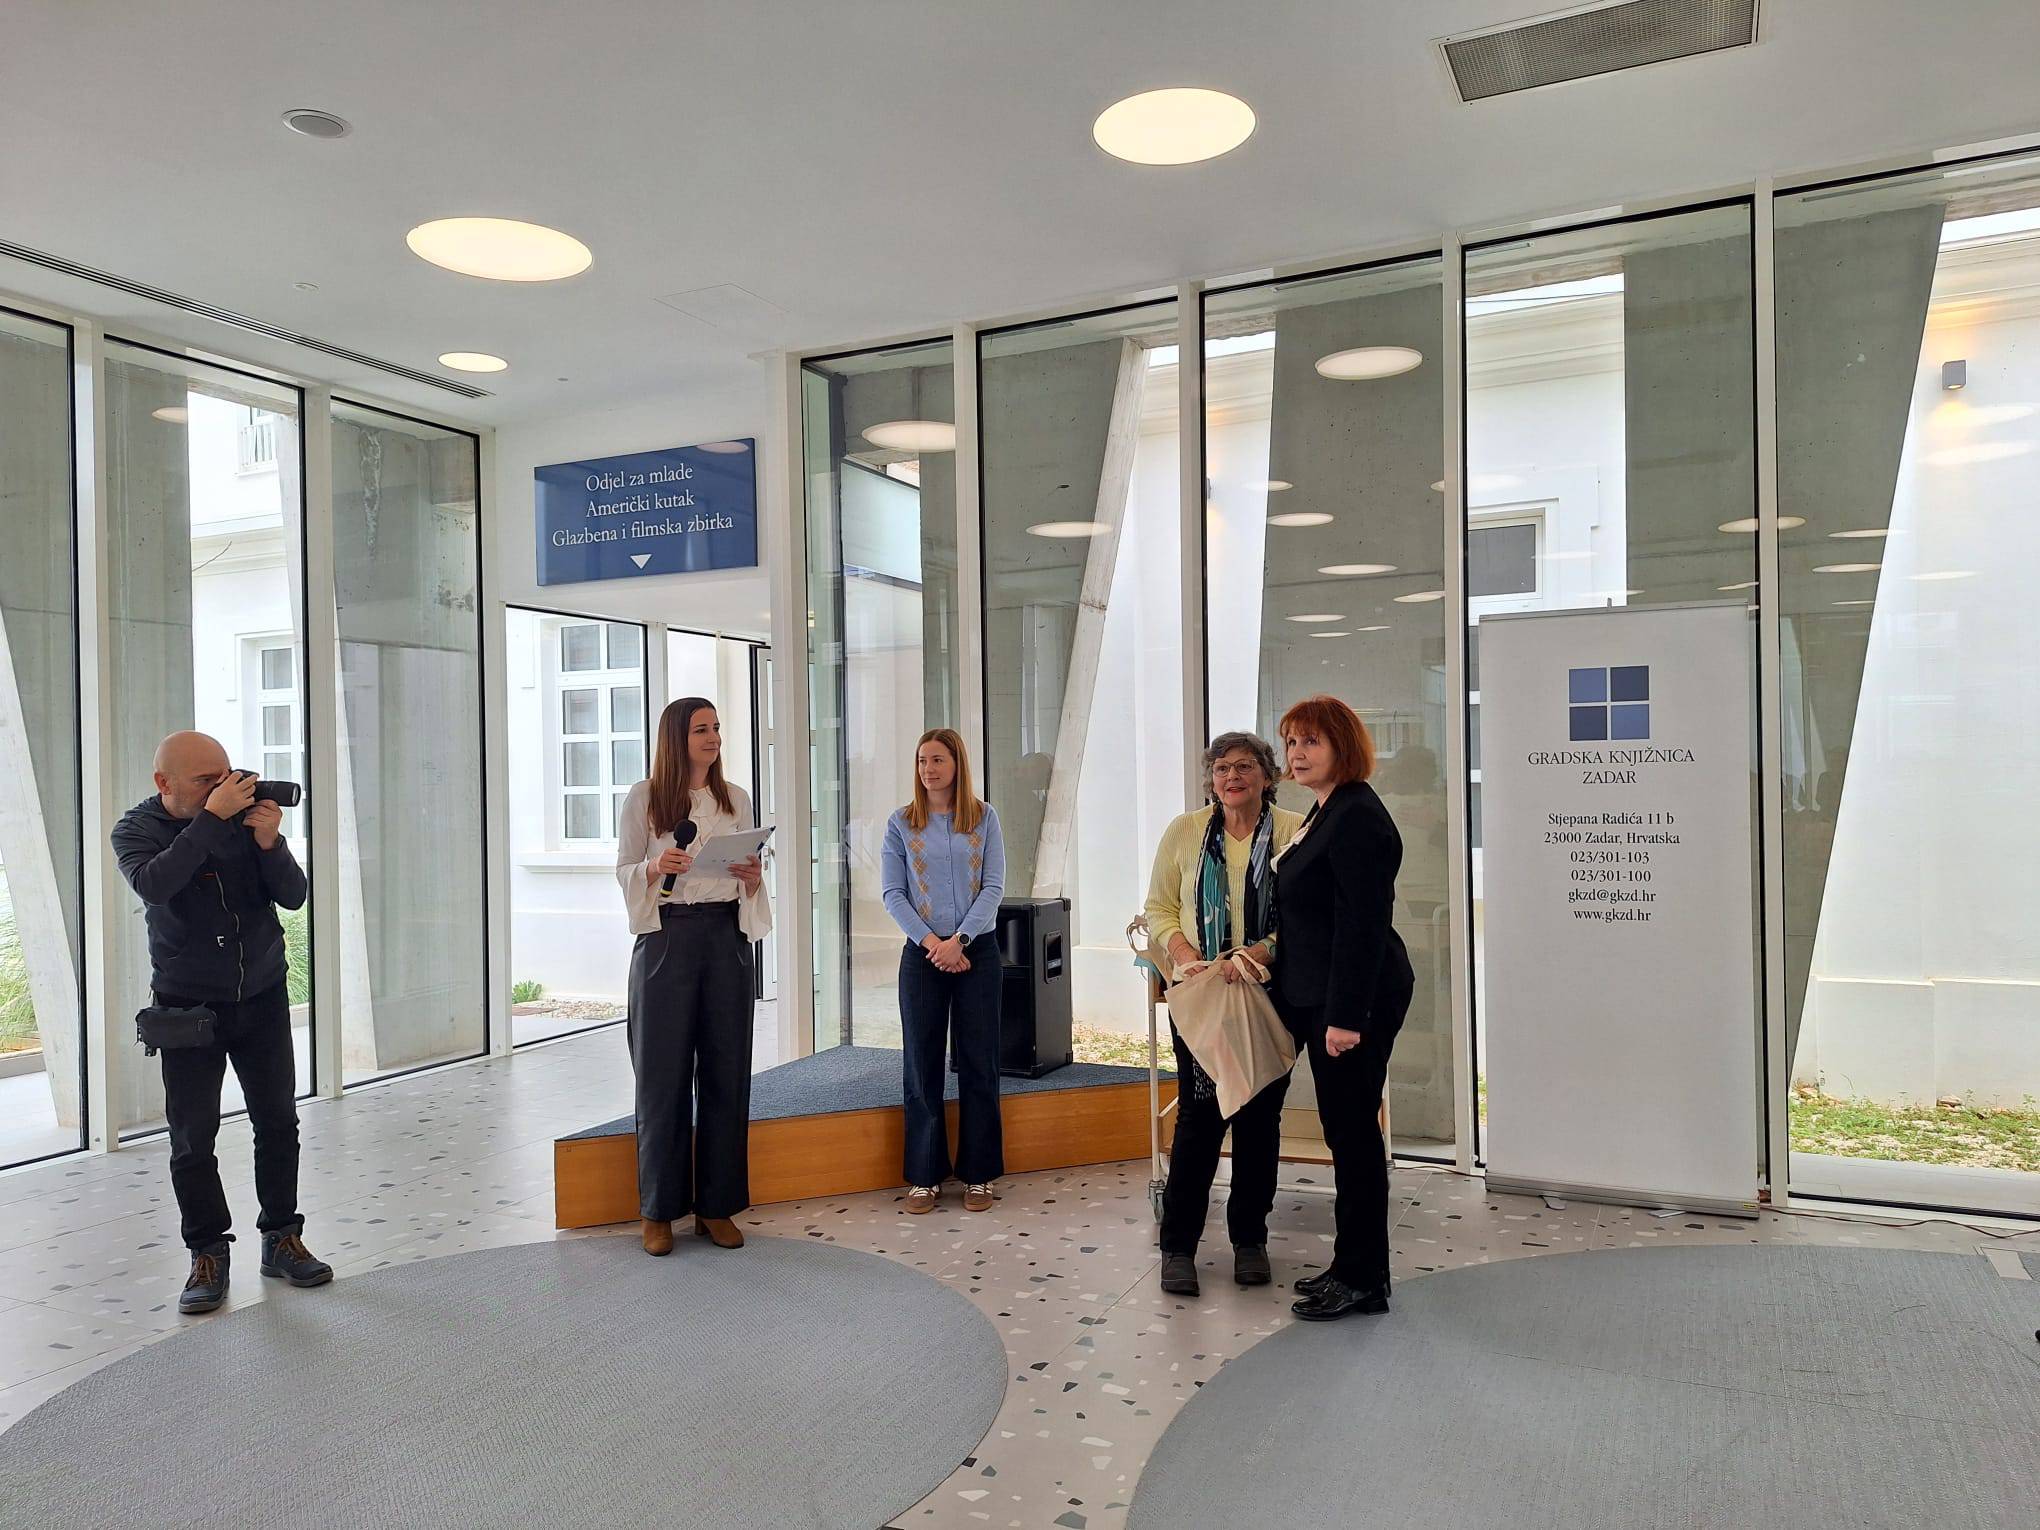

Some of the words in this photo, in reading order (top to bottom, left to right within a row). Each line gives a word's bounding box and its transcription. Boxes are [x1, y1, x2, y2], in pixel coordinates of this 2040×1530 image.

[586, 471, 625, 495] Odjel
[630, 473, 644, 486] za
[650, 463, 693, 482] mlade
[586, 496, 650, 518] Američki
[654, 490, 695, 509] kutak
[553, 526, 617, 547] Glazbena
[622, 523, 626, 538] i
[631, 519, 682, 539] filmska
[688, 513, 733, 532] zbirka
[1528, 751, 1603, 765] GRADSKA
[1609, 747, 1695, 767] KNJIŽNICA
[1583, 771, 1637, 784] ZADAR
[1548, 812, 1598, 827] Stjepana
[1602, 812, 1642, 825] Radića
[1647, 812, 1661, 824] 11
[1666, 812, 1674, 824] b
[1544, 833, 1581, 843] 23000
[1585, 832, 1622, 845] Zadar,
[1627, 832, 1680, 844] Hrvatska
[1570, 851, 1649, 863] 023/301-103
[1571, 870, 1651, 882] 023/301-100
[1568, 889, 1656, 903] gkzd@gkzd.hr
[1574, 909, 1651, 923] www.gkzd.hr
